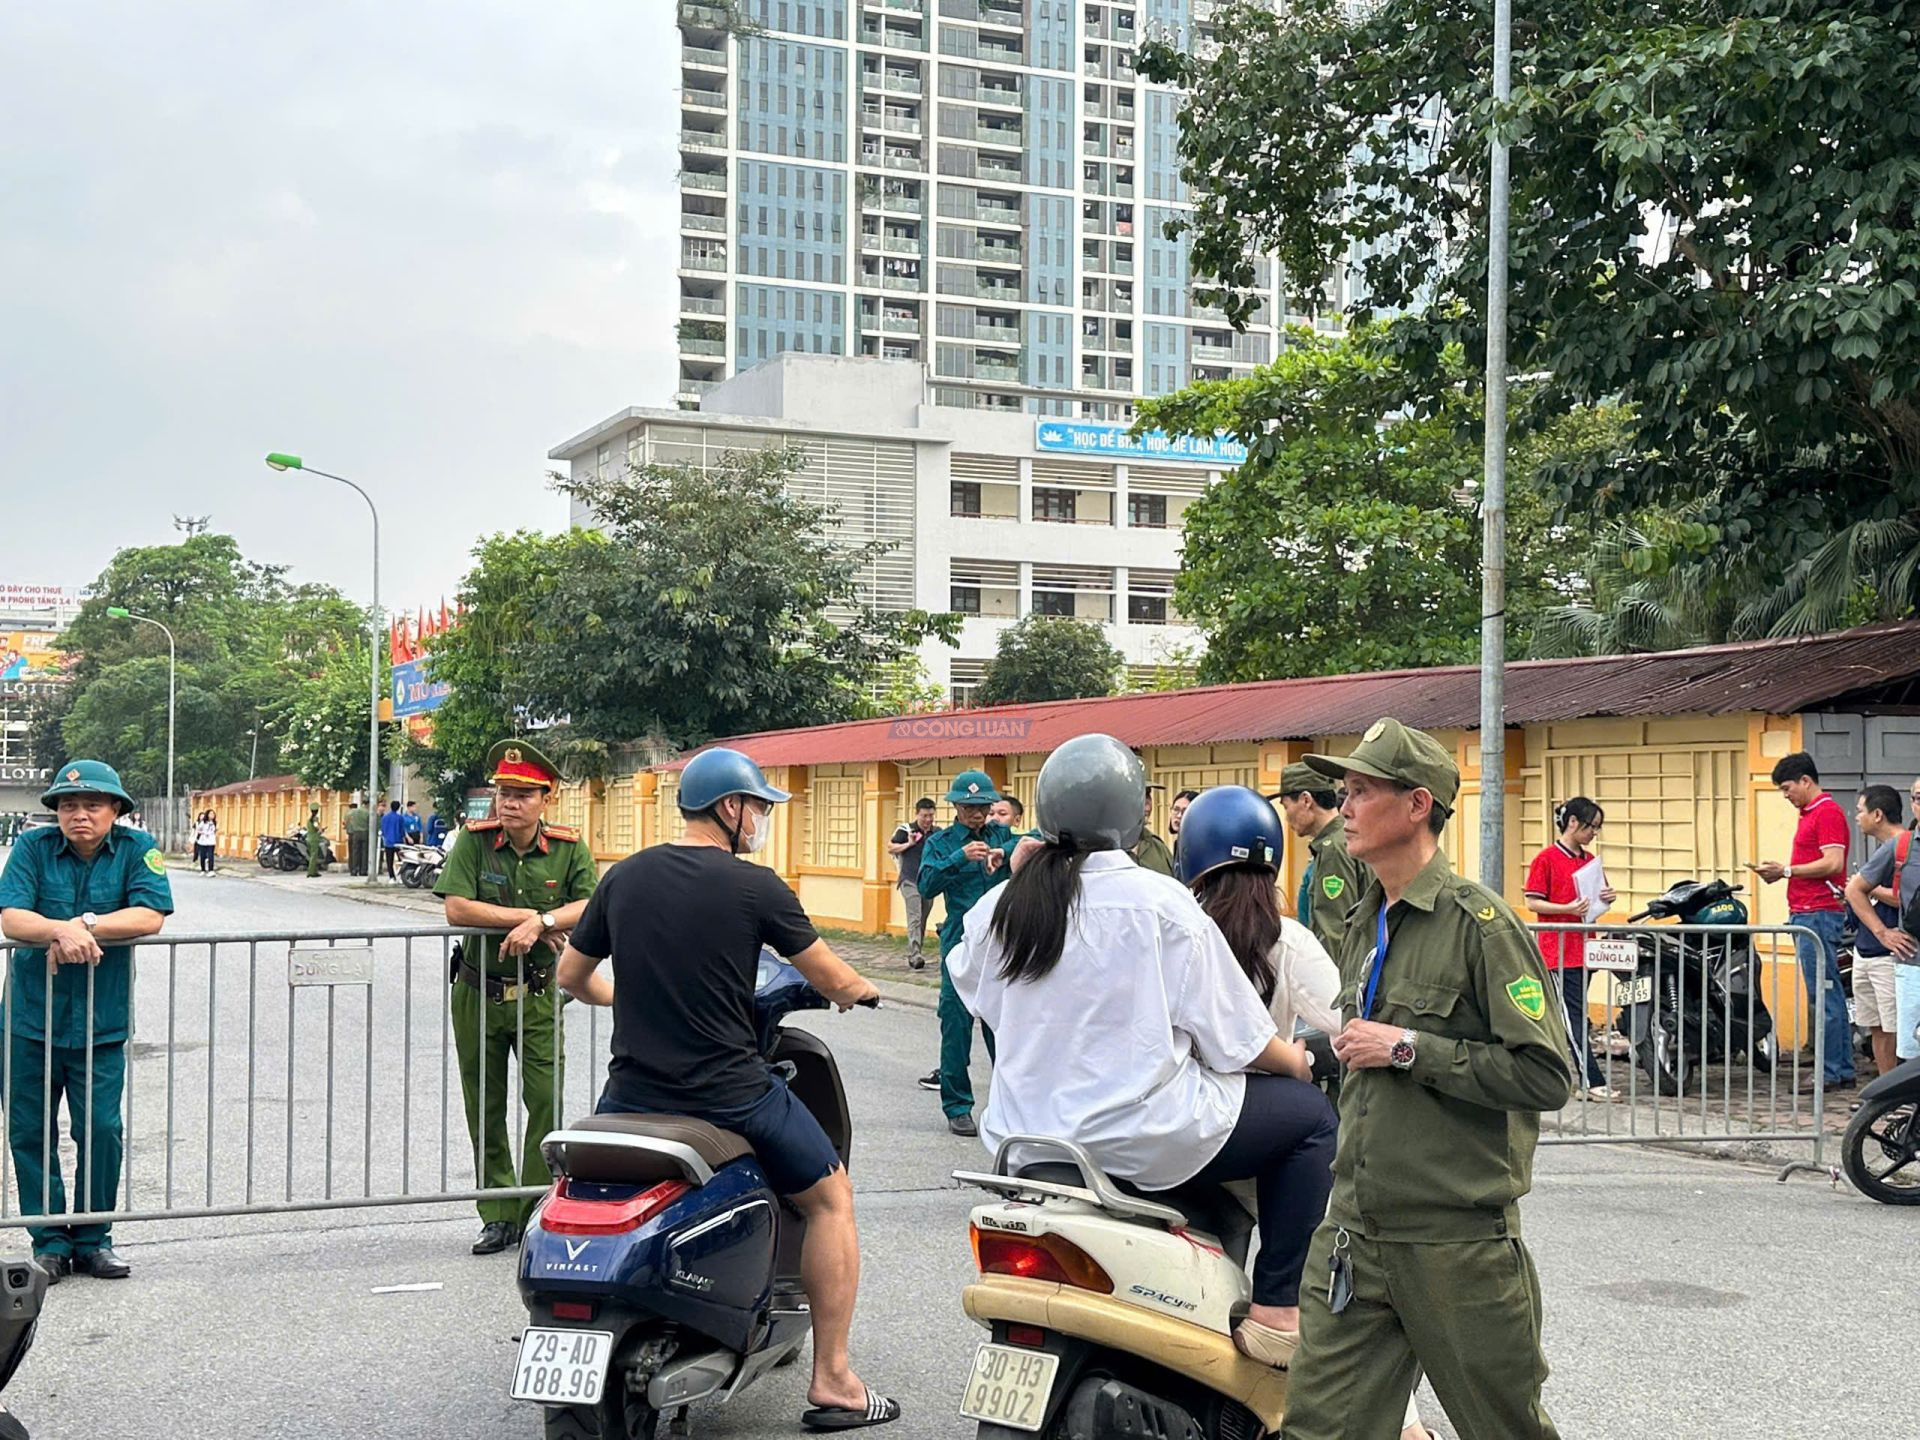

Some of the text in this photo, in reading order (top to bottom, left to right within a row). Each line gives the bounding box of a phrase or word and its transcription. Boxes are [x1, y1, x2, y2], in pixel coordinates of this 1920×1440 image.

[1146, 436, 1168, 454] HỌC
[25, 585, 41, 593] CHO
[546, 1263, 598, 1273] VINFAST
[1128, 1284, 1183, 1308] SPACY
[531, 1333, 598, 1365] 29-AD
[522, 1365, 599, 1399] 188.96
[972, 1383, 1035, 1423] 9902
